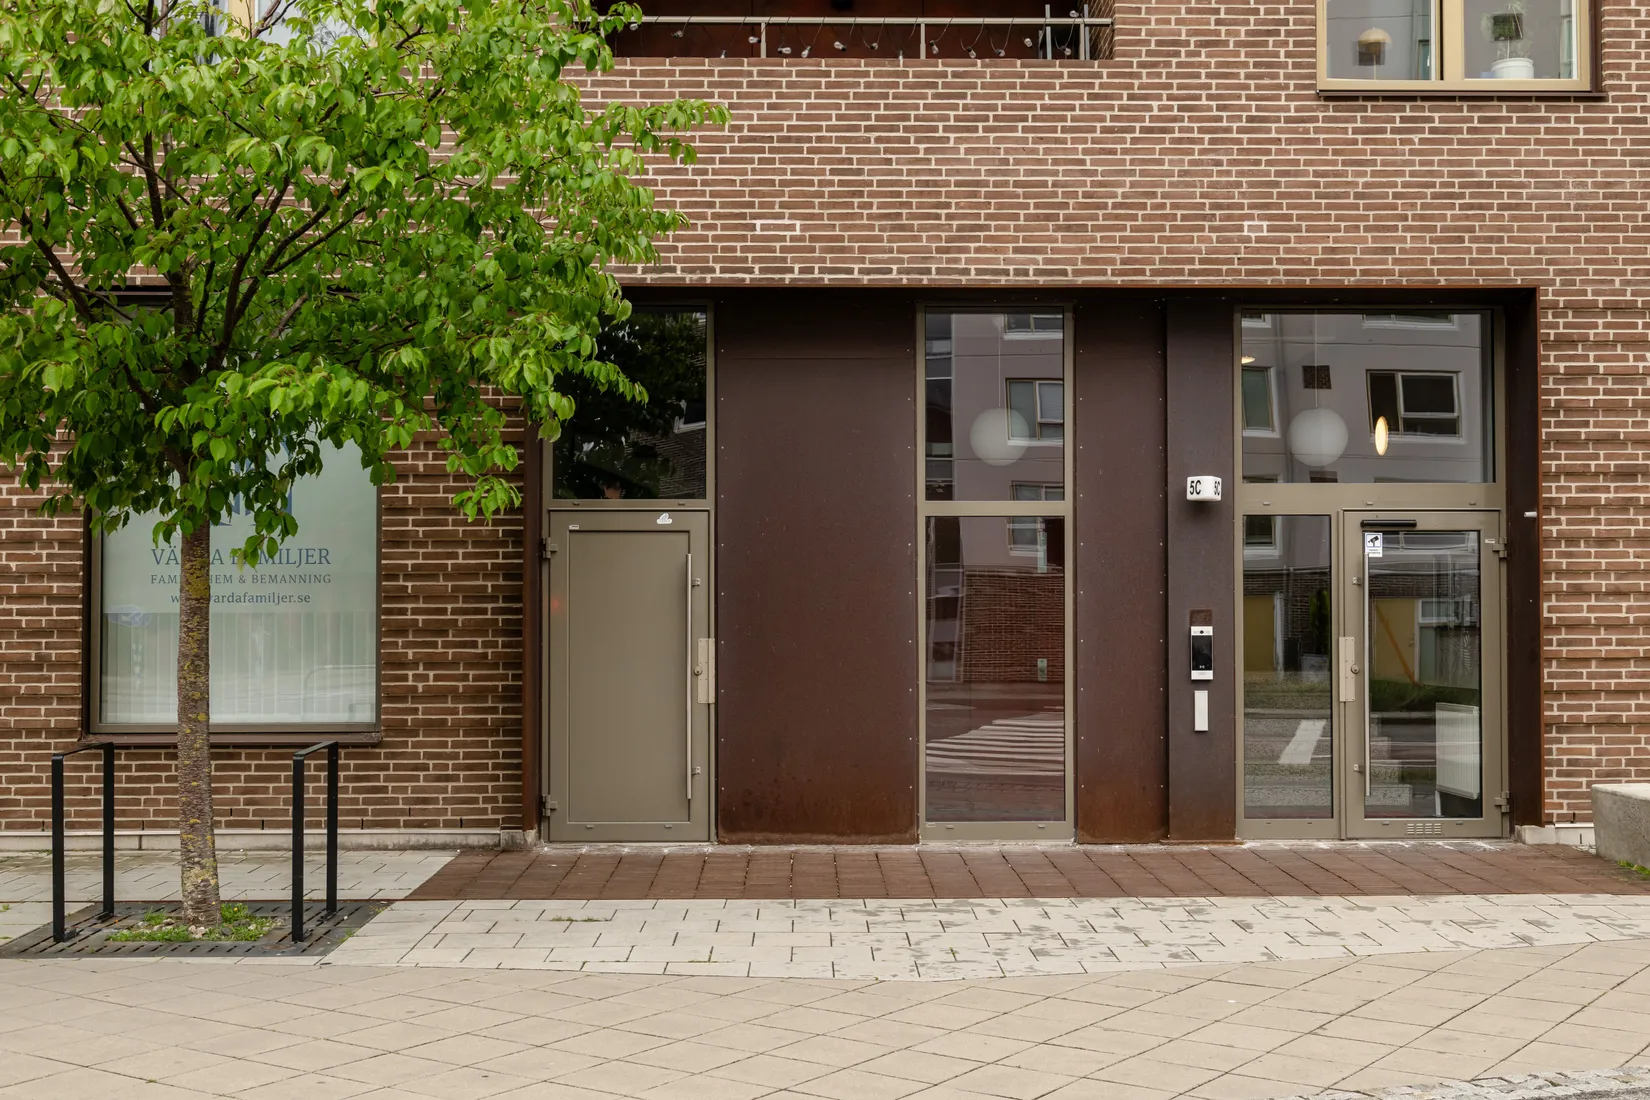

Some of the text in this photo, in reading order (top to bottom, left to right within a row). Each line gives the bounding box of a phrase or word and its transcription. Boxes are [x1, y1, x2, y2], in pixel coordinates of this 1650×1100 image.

[1190, 480, 1201, 495] 5C
[1214, 480, 1220, 496] 5C
[151, 545, 224, 565] VÄA
[239, 574, 246, 584] &
[252, 574, 331, 584] BEMANNING
